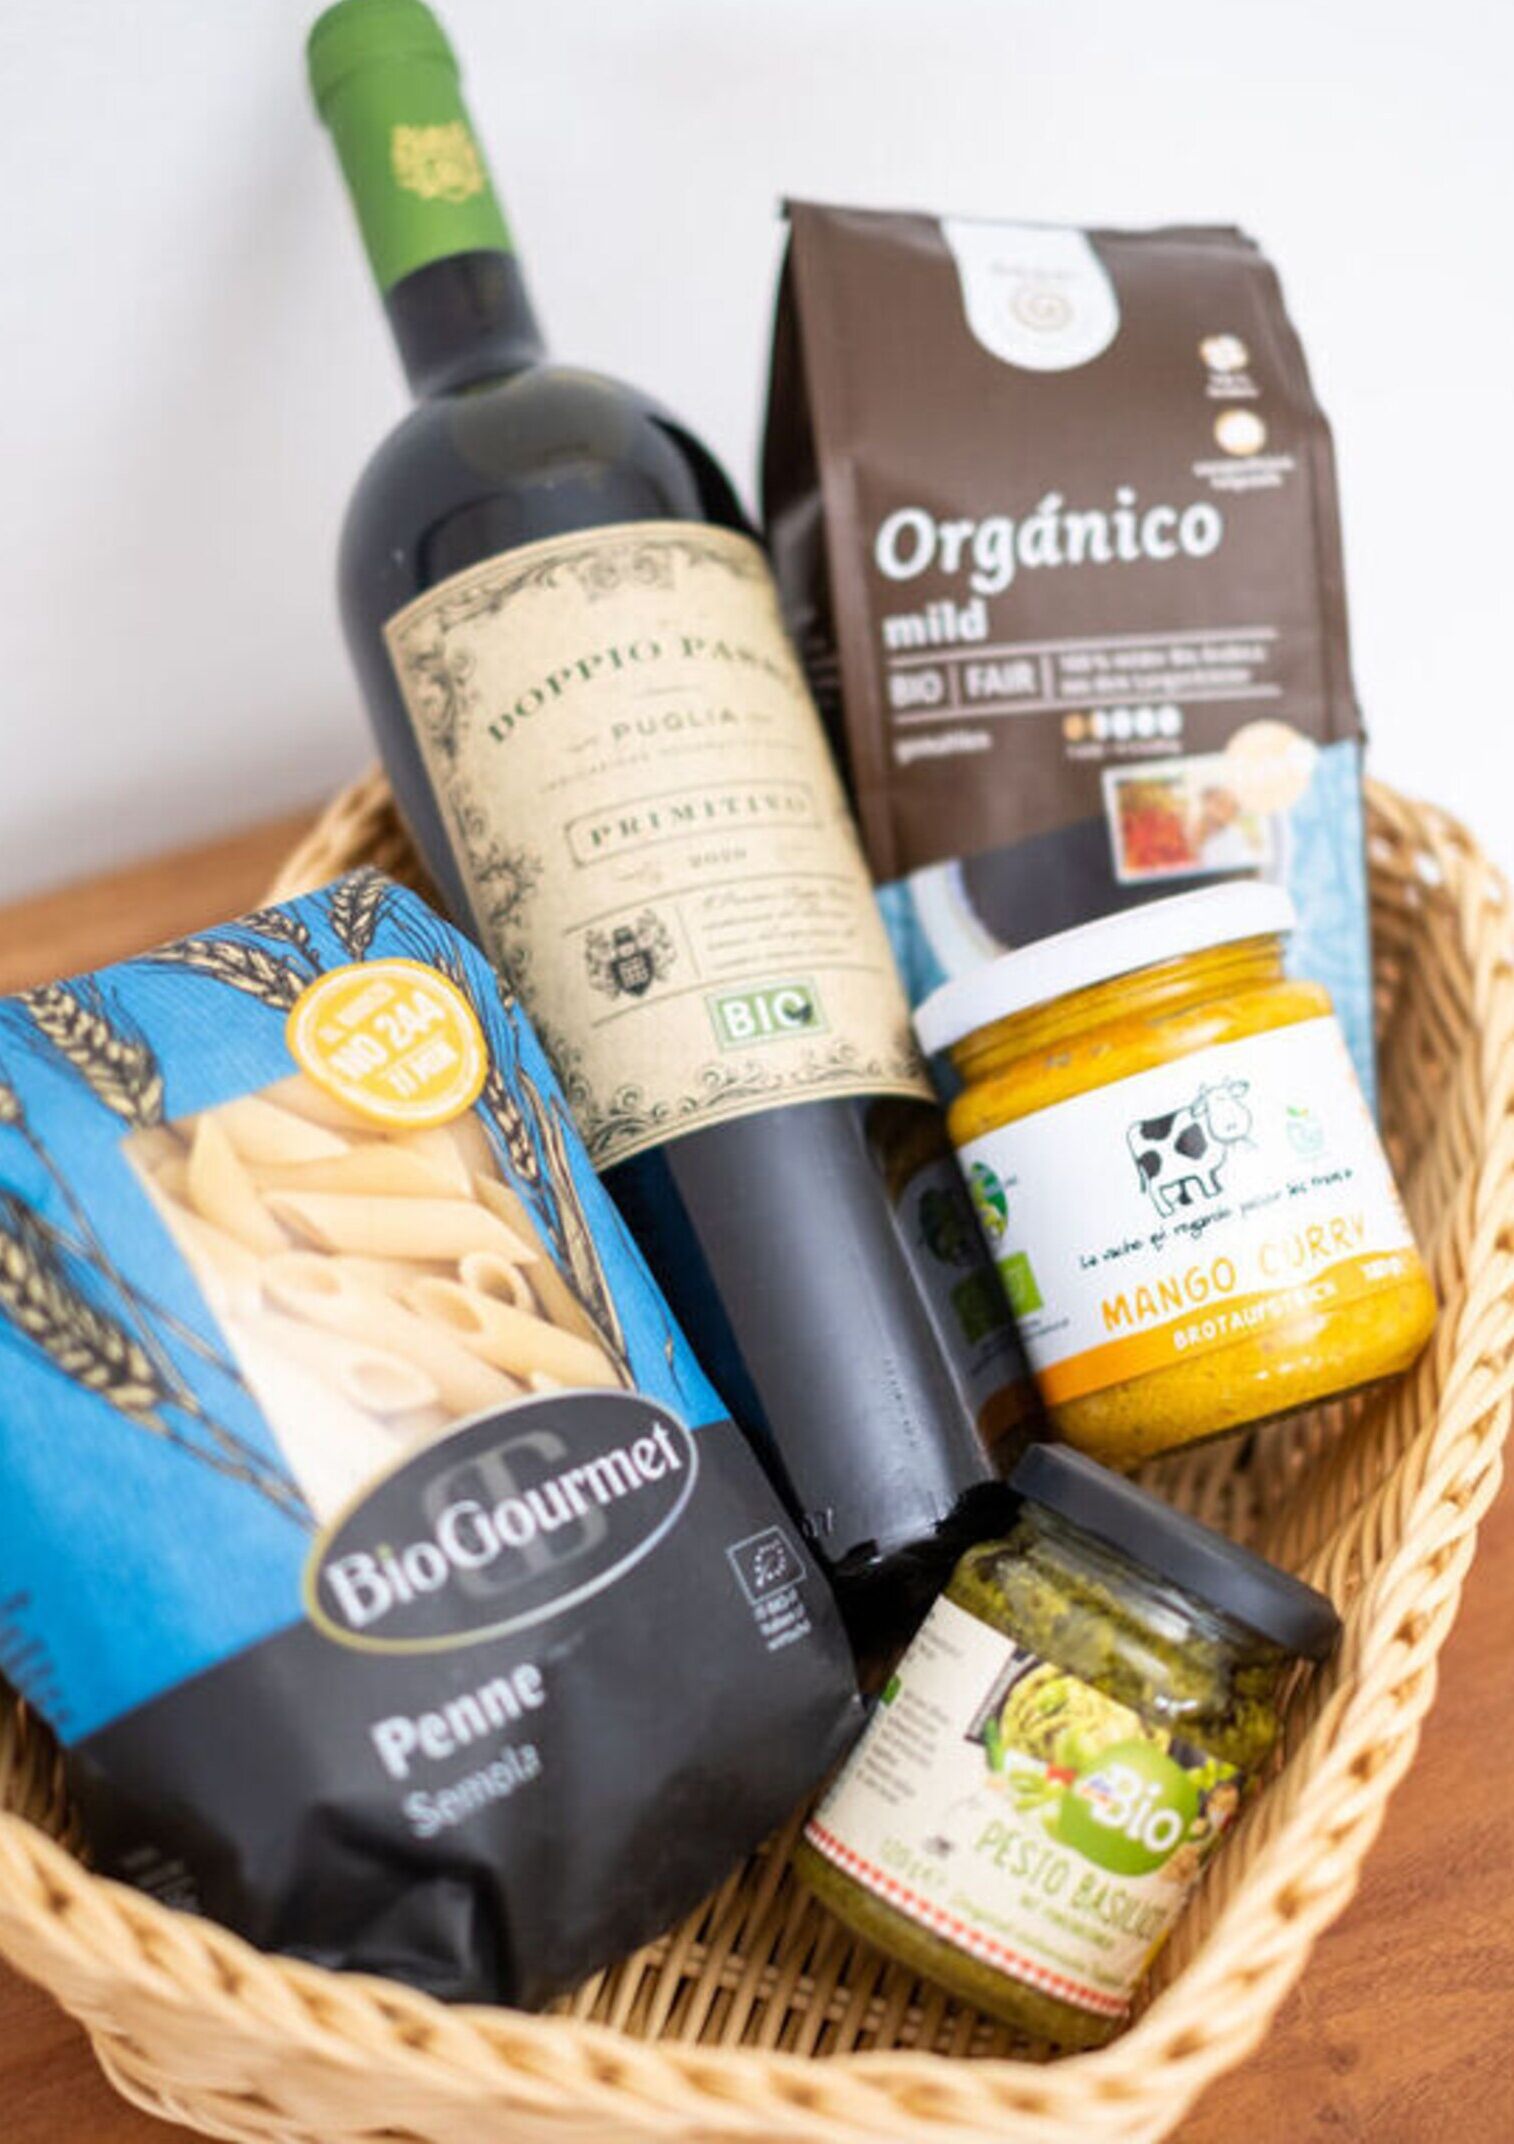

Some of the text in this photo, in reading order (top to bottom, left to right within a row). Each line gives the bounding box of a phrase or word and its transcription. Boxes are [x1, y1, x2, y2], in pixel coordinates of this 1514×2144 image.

[876, 487, 1222, 594] Orgánico
[883, 598, 988, 648] mild
[487, 638, 662, 744] DOPPIO
[965, 662, 1036, 697] FAIR
[611, 707, 739, 741] PUGLIA
[591, 795, 809, 847] PRIMITIVO
[721, 989, 814, 1040] BIO
[1101, 1257, 1237, 1333] MANGO
[1258, 1211, 1367, 1277] CURRY
[325, 1421, 683, 1629] BioGourmet
[370, 1661, 547, 1780] Penne
[975, 1819, 1071, 1897] PESTO
